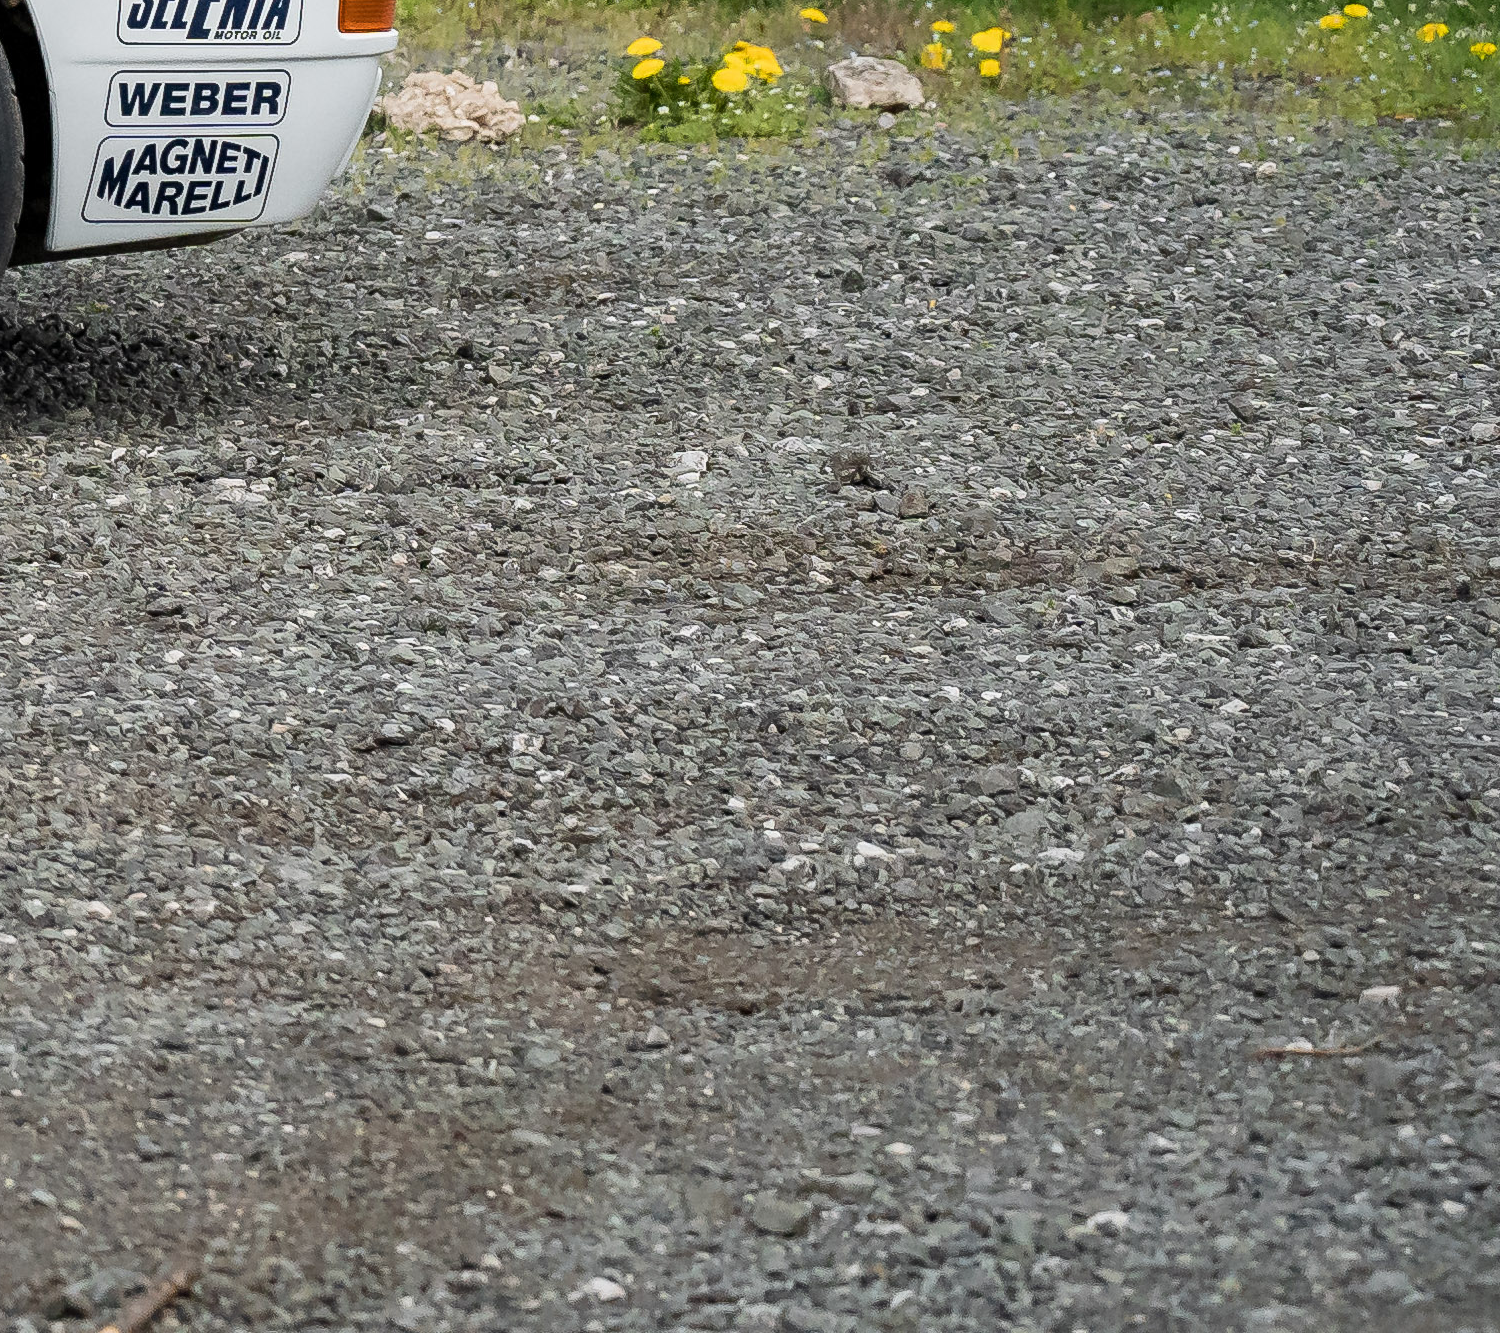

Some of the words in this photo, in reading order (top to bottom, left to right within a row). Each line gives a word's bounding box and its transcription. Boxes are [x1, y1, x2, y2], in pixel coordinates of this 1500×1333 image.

[214, 31, 258, 40] MOTOR
[263, 31, 282, 40] OIL
[119, 82, 282, 116] WEBER
[97, 139, 269, 205] MAGNETI
